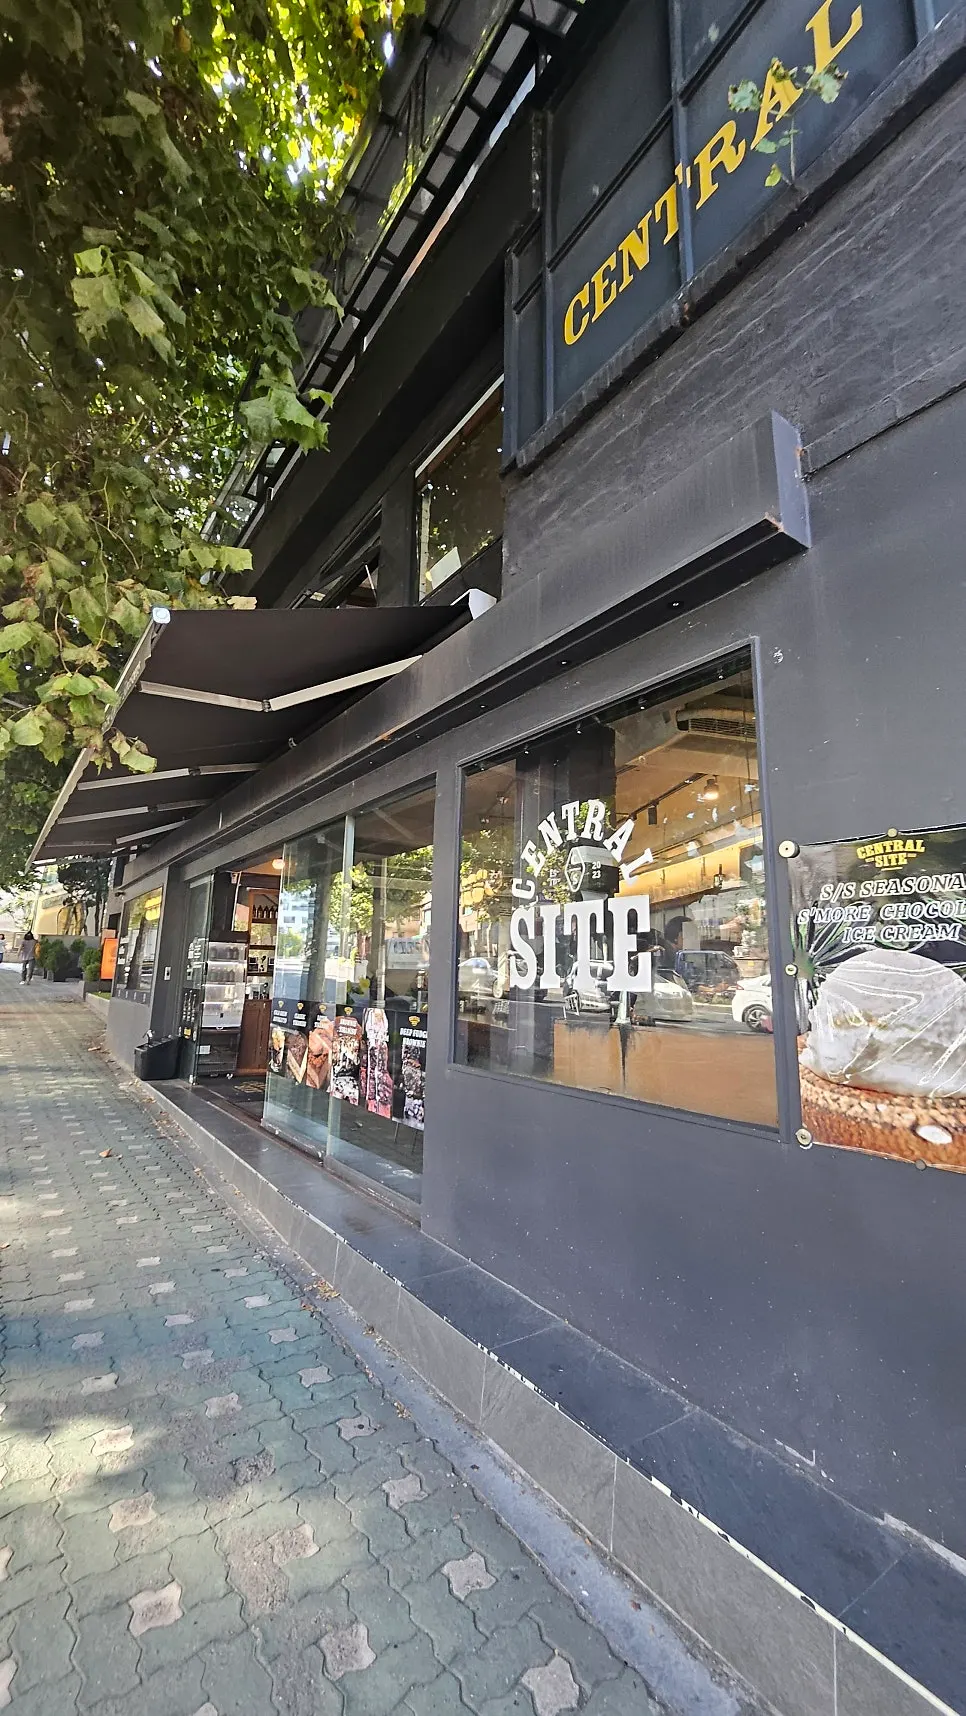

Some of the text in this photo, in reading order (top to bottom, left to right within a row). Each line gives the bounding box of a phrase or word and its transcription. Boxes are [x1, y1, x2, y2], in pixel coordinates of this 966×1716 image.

[563, 0, 863, 346] CENTRAL
[512, 798, 654, 900] CENTRAL
[856, 839, 926, 859] CENTRAL
[875, 852, 908, 868] SITE
[820, 873, 966, 903] S/S SEASONA
[797, 904, 872, 924] S'MORE
[509, 894, 652, 992] SITE
[842, 923, 963, 943] ICE CREAM
